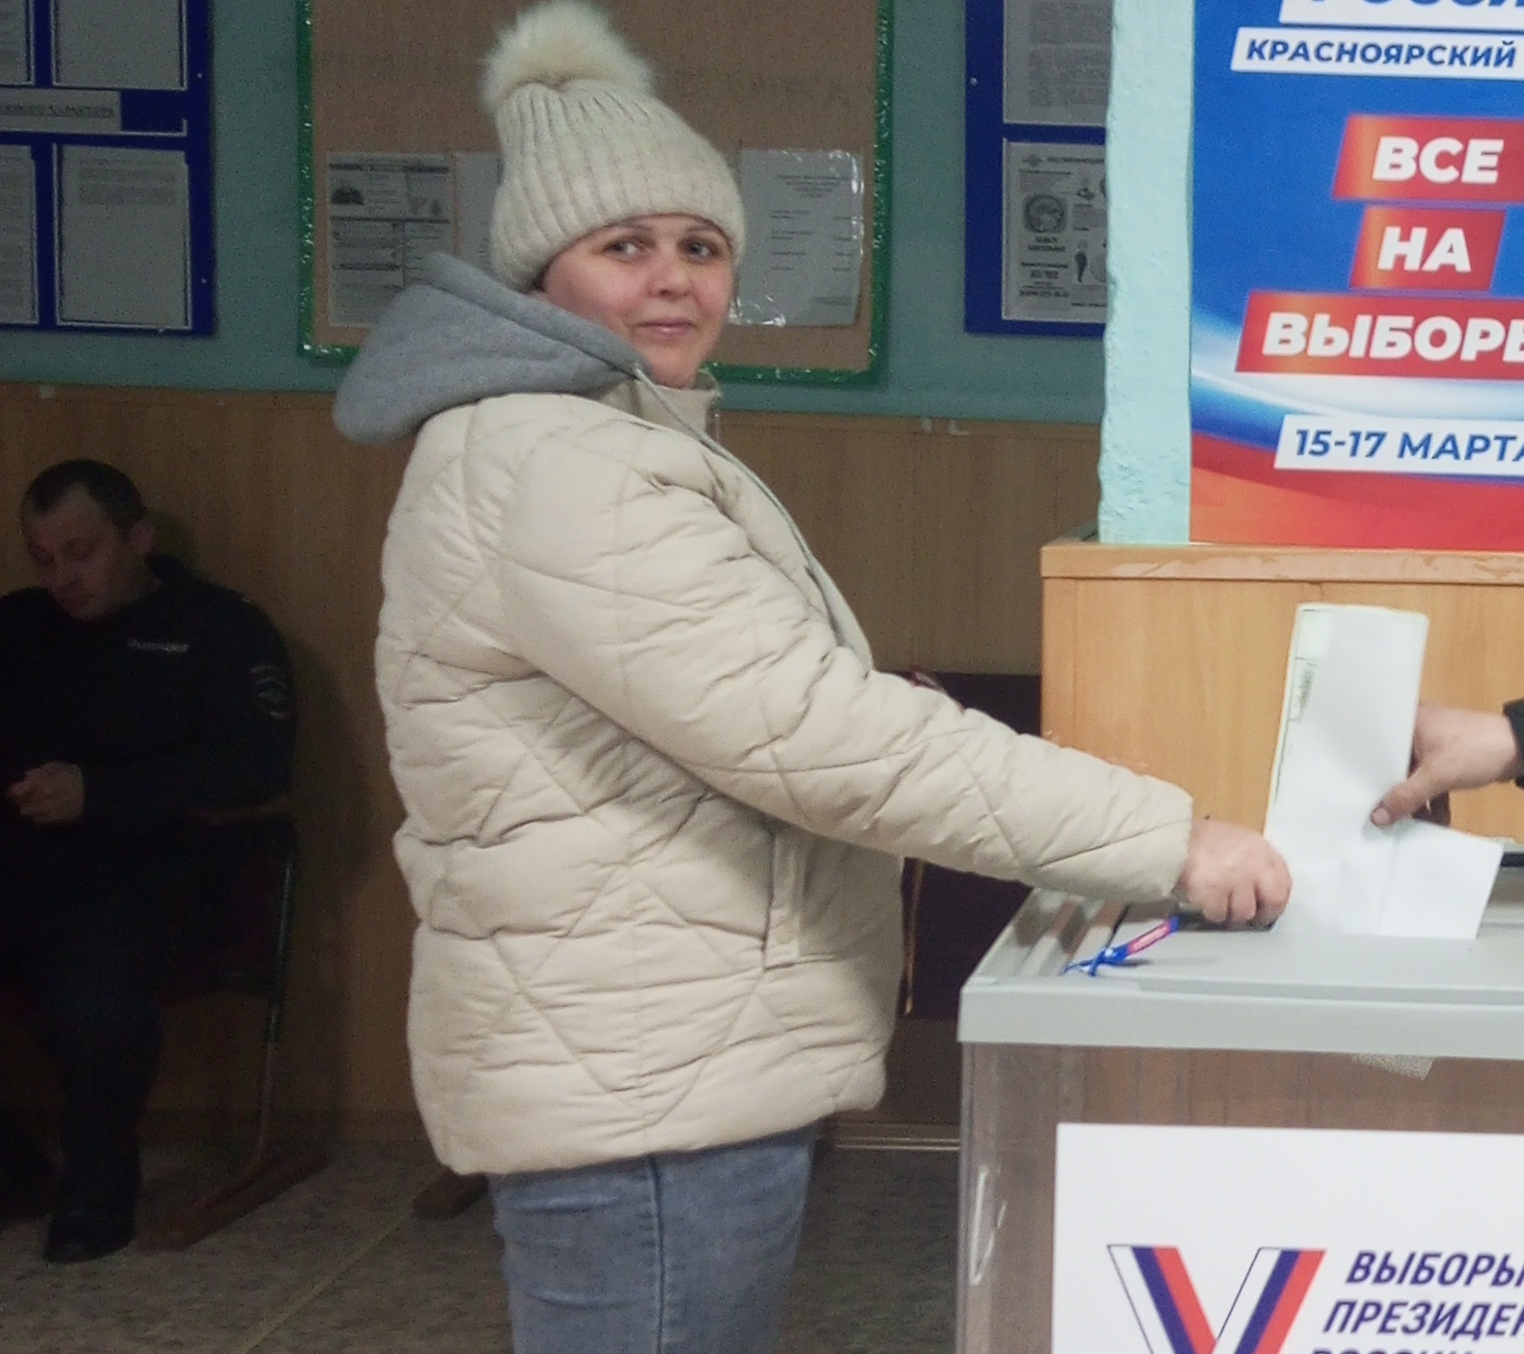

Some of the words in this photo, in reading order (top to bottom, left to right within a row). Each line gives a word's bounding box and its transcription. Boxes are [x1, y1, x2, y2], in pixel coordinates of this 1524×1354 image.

[1245, 38, 1516, 69] КРАСНОЯРСКИЙ
[1371, 135, 1505, 184] ВСЕ
[1377, 226, 1472, 273] НА
[1295, 428, 1388, 459] 15-17
